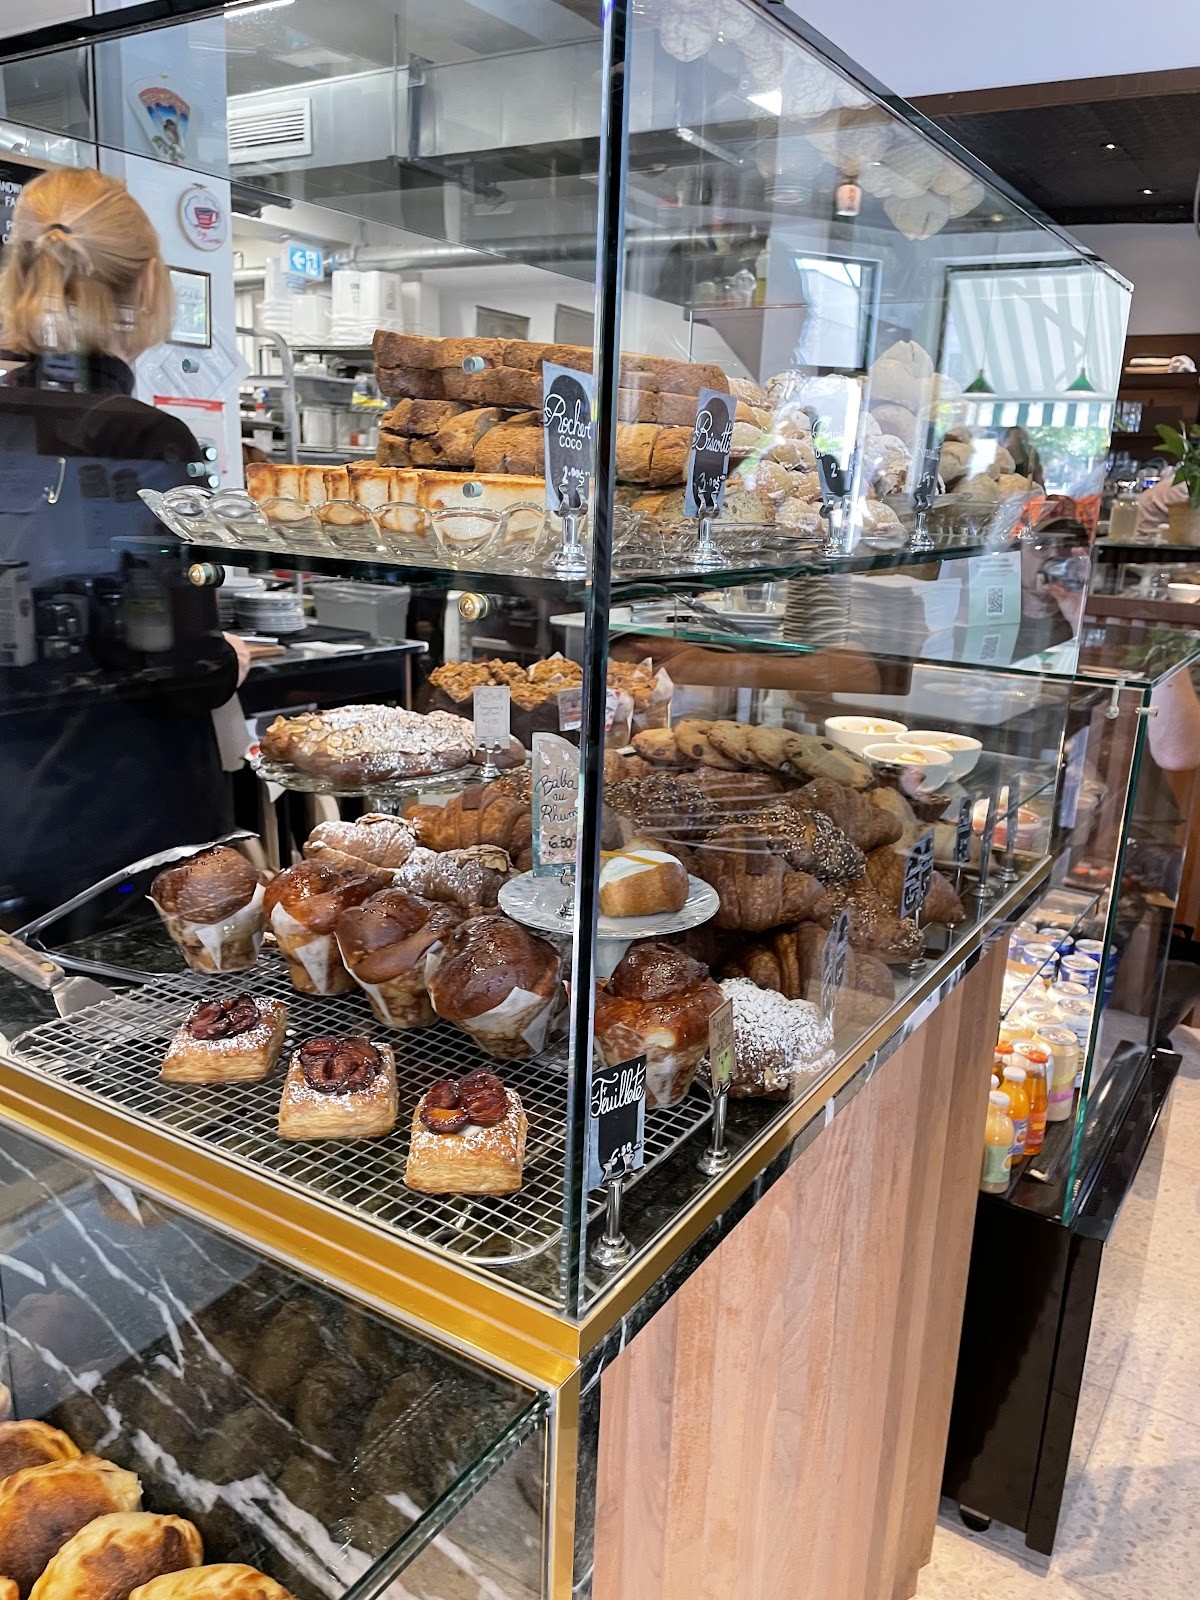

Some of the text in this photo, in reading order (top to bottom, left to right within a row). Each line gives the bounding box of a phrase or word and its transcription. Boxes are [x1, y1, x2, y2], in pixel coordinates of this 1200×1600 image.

[543, 393, 592, 440] Rocher
[692, 410, 732, 453] Biscotti
[535, 768, 579, 796] Baba
[552, 792, 567, 802] au
[540, 804, 578, 823] Rhum
[590, 1063, 646, 1117] Feuilleté
